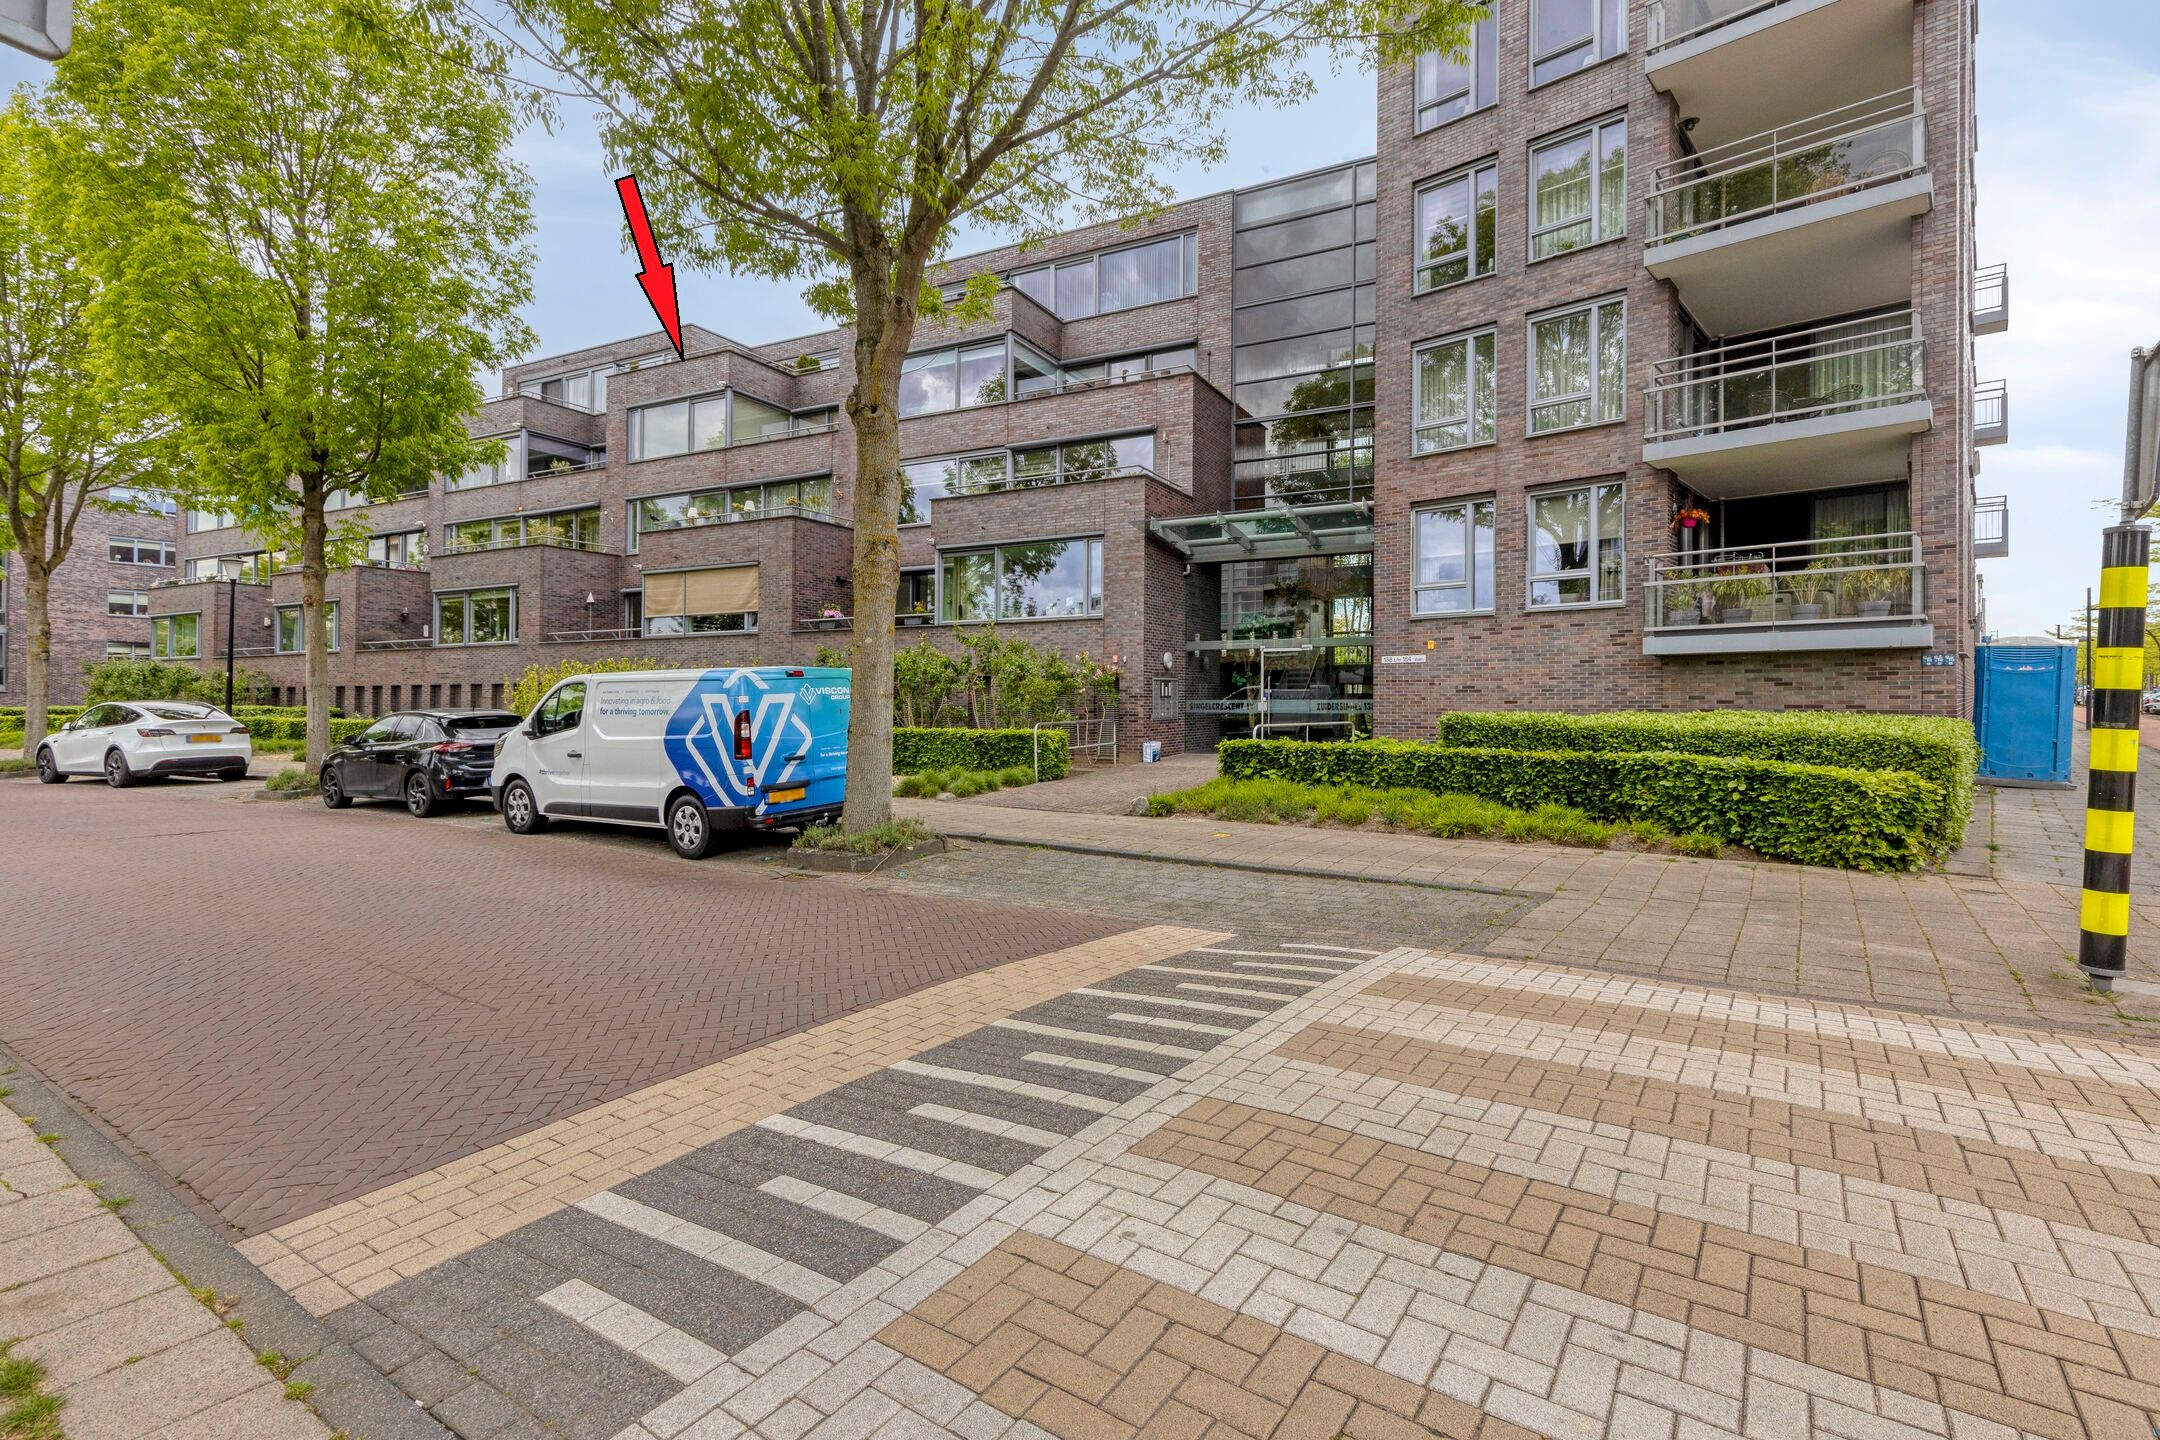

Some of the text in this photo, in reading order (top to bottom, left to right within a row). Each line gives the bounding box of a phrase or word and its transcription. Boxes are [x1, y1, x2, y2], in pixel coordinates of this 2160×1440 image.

[815, 687, 850, 695] VISCON
[600, 696, 629, 706] Innovating
[636, 698, 650, 706] agro
[651, 696, 656, 704] &
[657, 696, 671, 704] food
[600, 707, 608, 715] for
[615, 707, 637, 717] thriving
